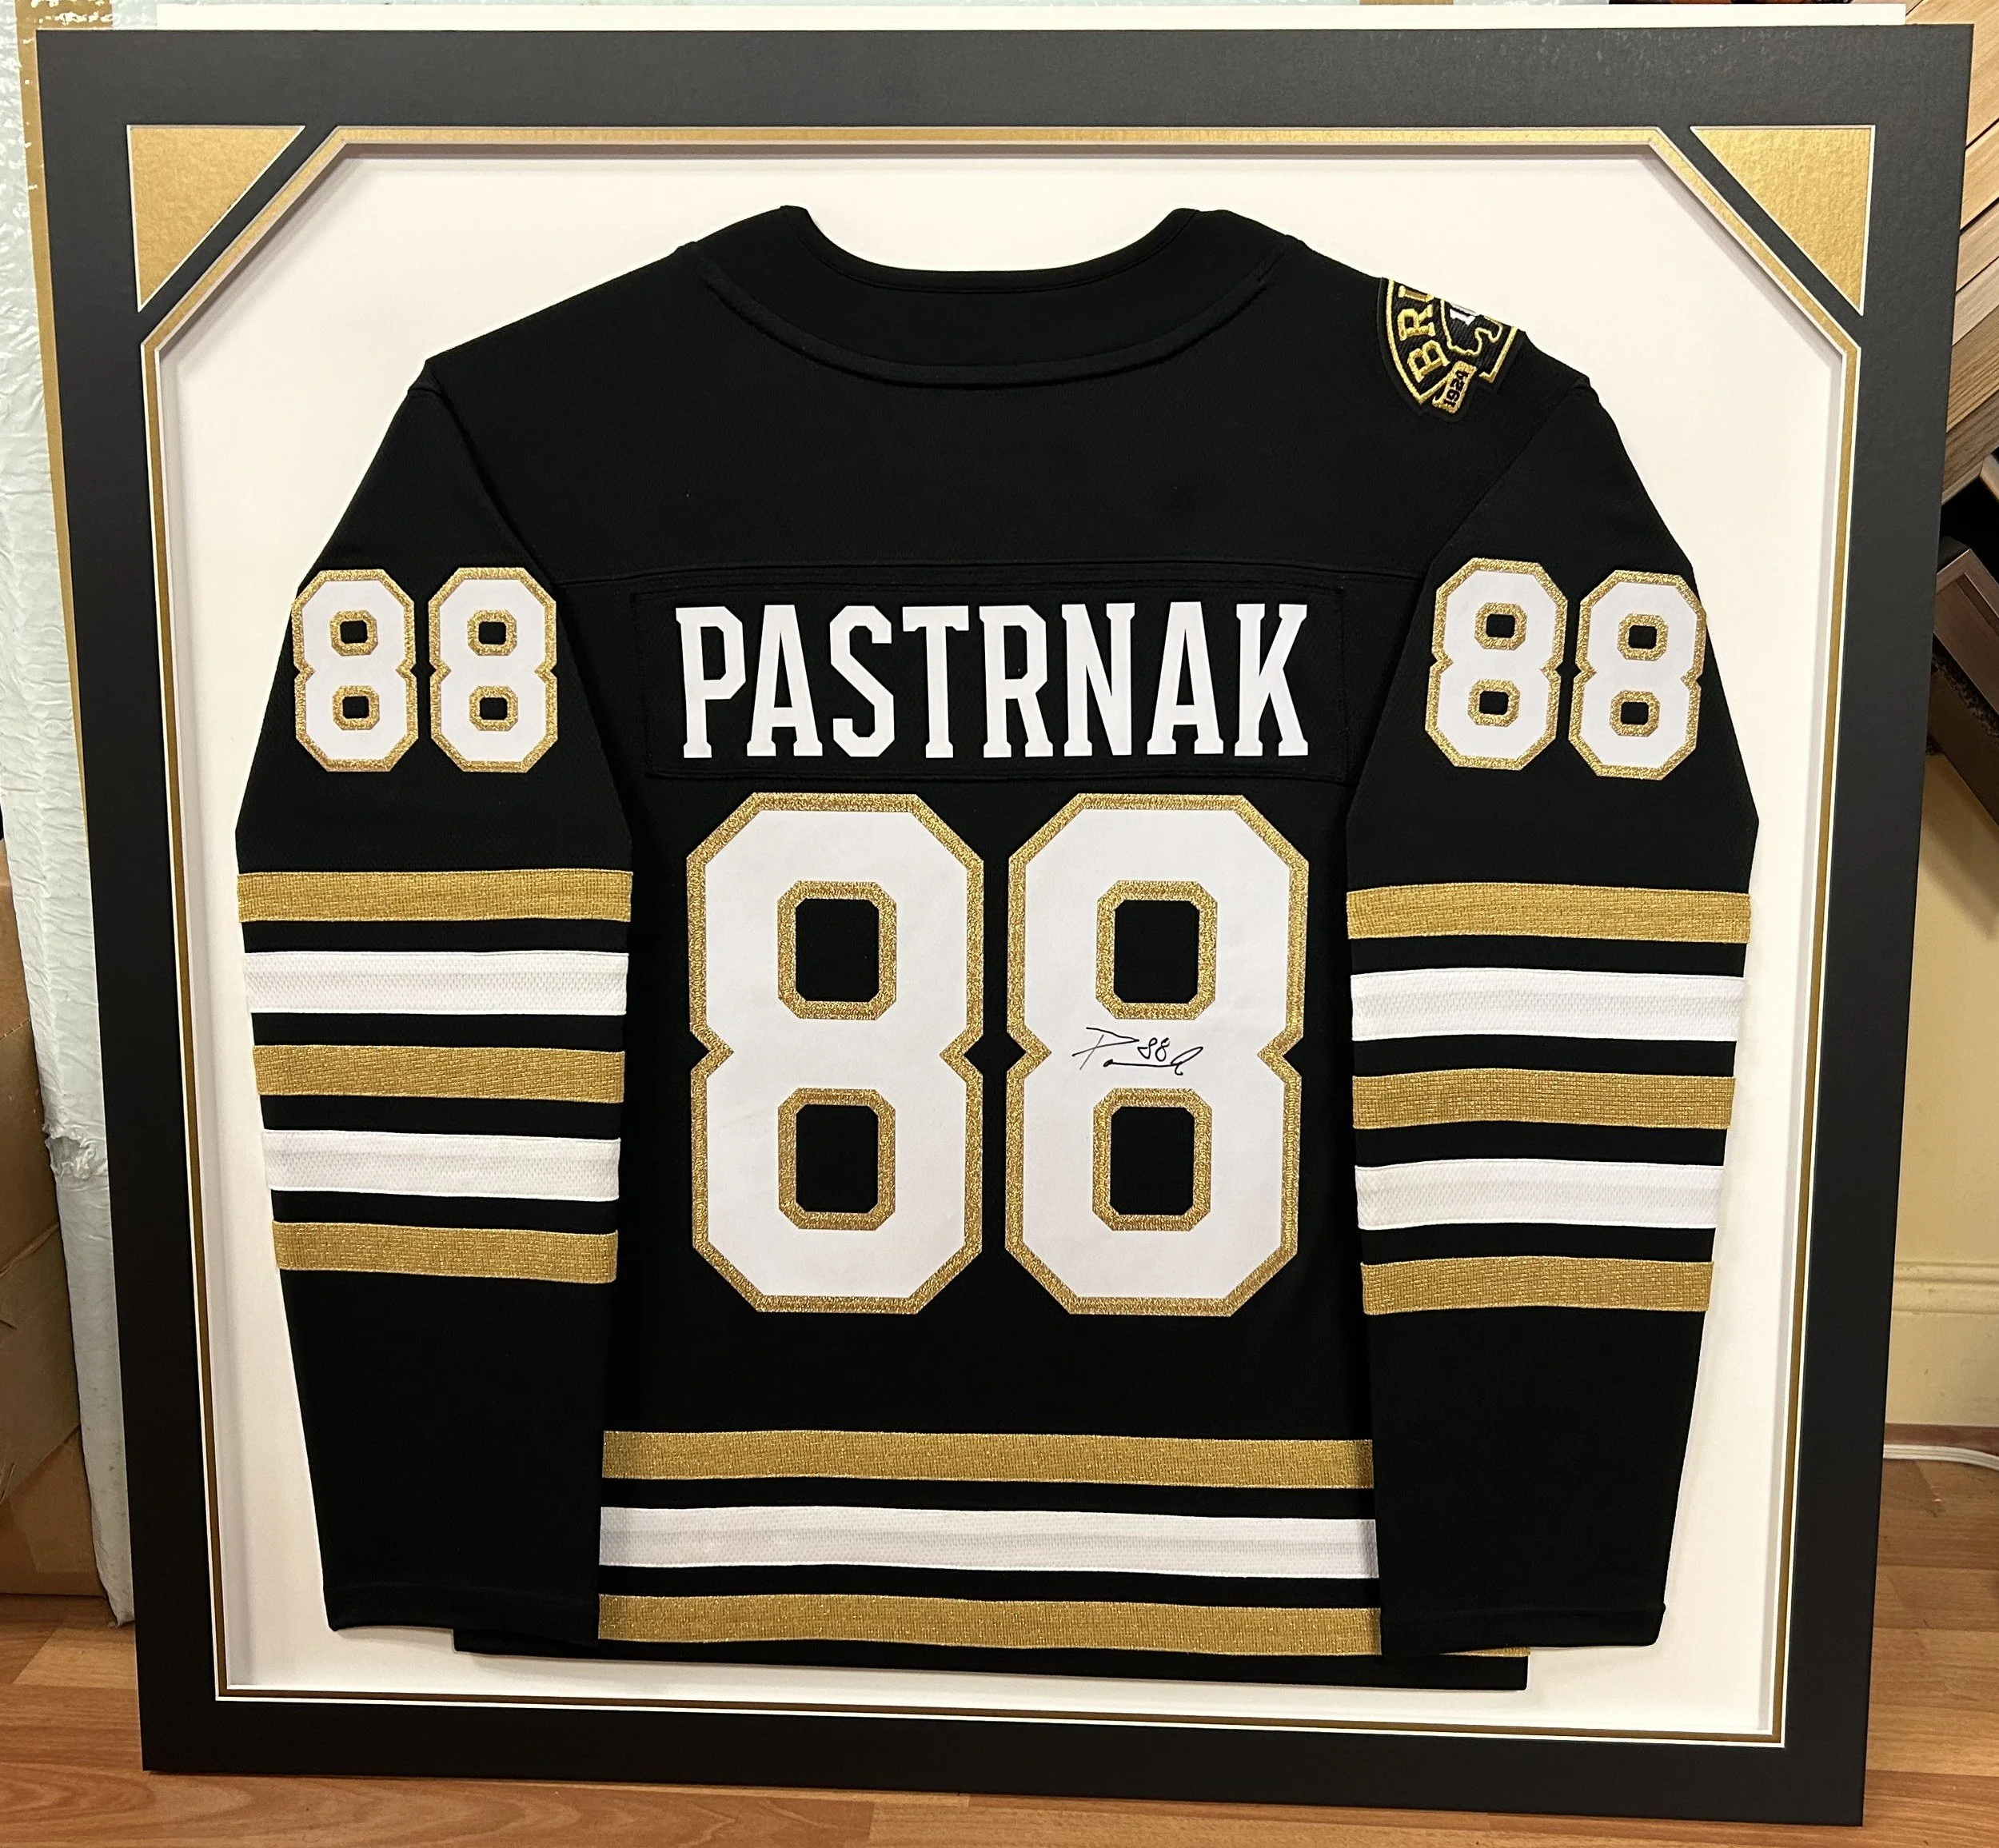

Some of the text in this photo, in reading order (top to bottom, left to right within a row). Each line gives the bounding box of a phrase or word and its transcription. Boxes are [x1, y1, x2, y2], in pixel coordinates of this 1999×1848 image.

[1443, 369, 1470, 409] 1924
[291, 567, 558, 773] 88
[676, 601, 1310, 759] PASTRNAK
[1425, 557, 1706, 780] 88
[686, 792, 1310, 1318] 88
